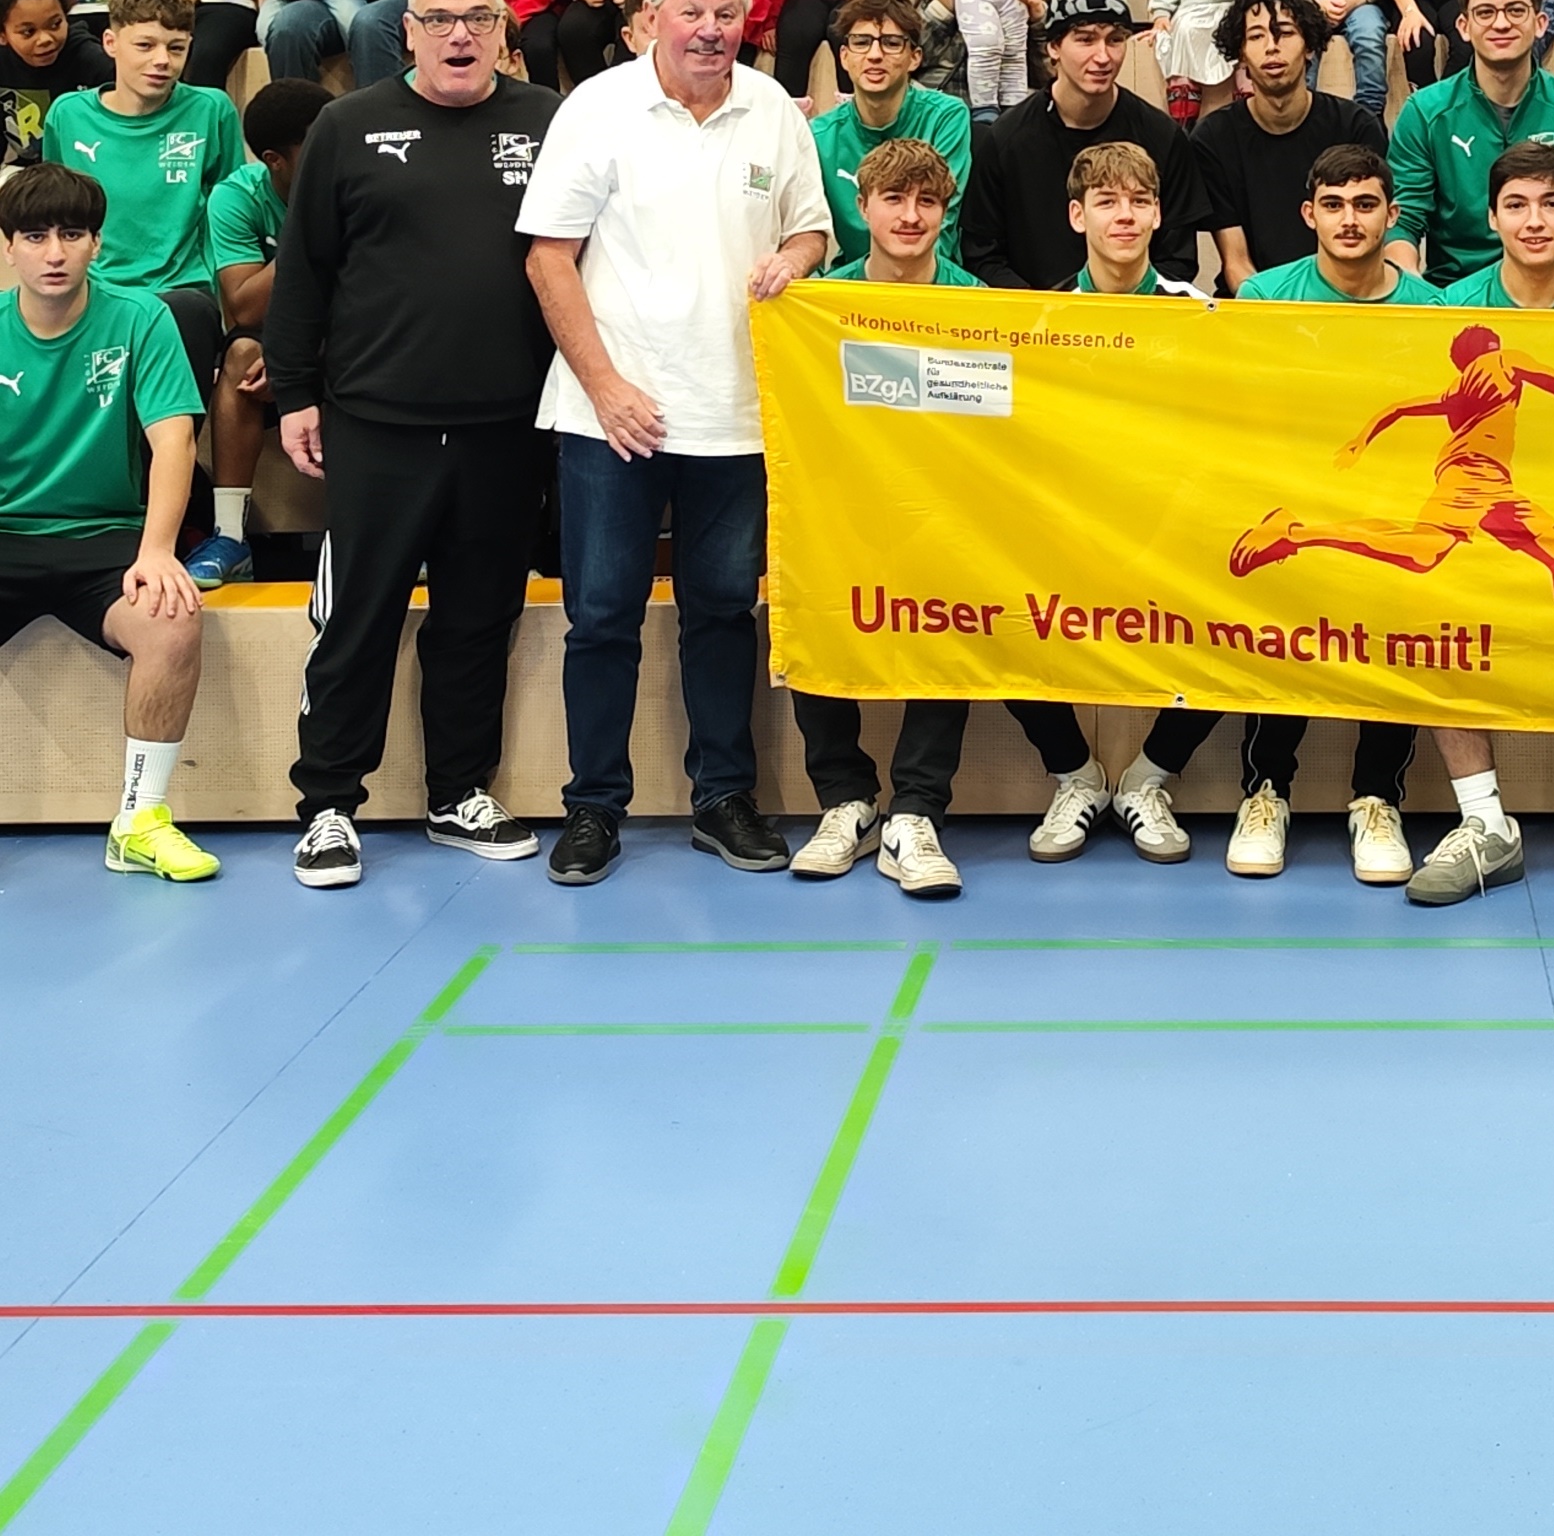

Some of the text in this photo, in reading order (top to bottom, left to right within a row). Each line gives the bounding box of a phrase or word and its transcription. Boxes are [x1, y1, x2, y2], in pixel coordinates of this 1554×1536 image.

[166, 169, 188, 183] LR
[502, 170, 528, 185] SH
[839, 312, 1135, 349] alkoholfrei-sport-geniessen.de
[926, 367, 940, 376] für
[850, 373, 918, 402] BZgA
[926, 380, 1009, 390] gesundheitliche
[927, 391, 983, 403] Aufklärung
[851, 585, 1492, 672] Unser Verein macht mit!
